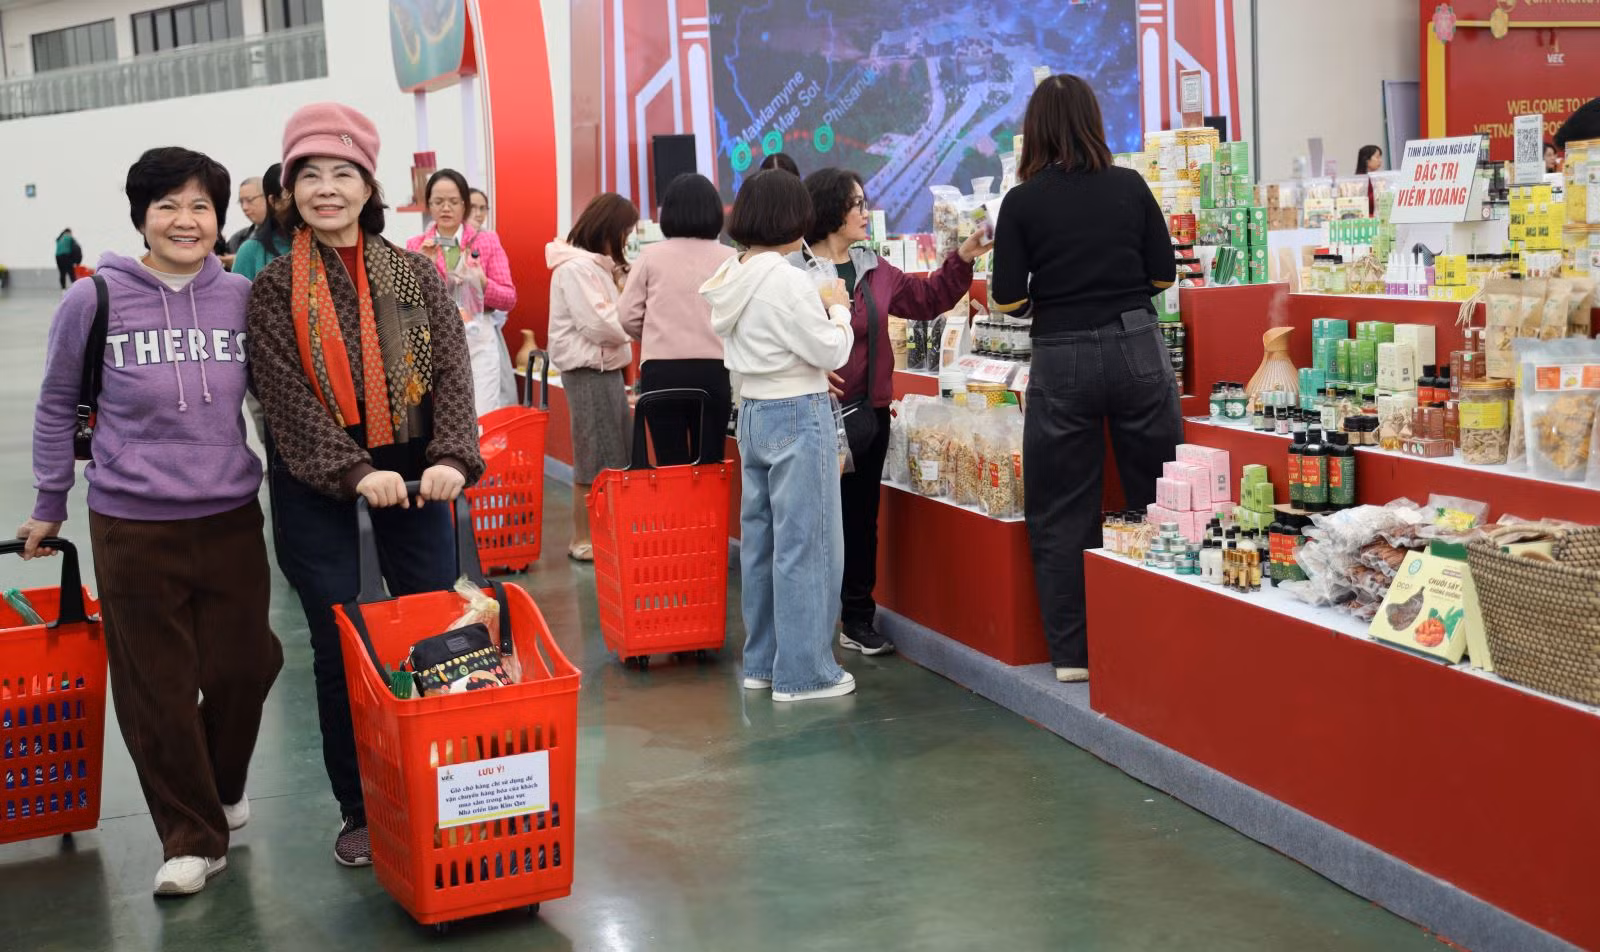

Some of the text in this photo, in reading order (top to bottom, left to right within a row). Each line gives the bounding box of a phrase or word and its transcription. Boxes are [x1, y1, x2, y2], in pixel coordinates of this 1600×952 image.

[773, 80, 821, 133] Mae Sot
[1507, 98, 1564, 115] WELCOME
[1566, 97, 1581, 112] TO
[1473, 122, 1514, 139] VIETNA
[1414, 160, 1459, 184] ĐẶC TRỊ
[1398, 185, 1467, 207] VIÊM XOANG
[106, 328, 247, 368] THERE'S
[478, 768, 494, 777] LƯU
[475, 782, 490, 790] hàng
[509, 776, 525, 785] dụng
[480, 789, 495, 798] hàng
[520, 781, 539, 790] khách
[486, 796, 502, 805] trong
[514, 800, 527, 808] Quy
